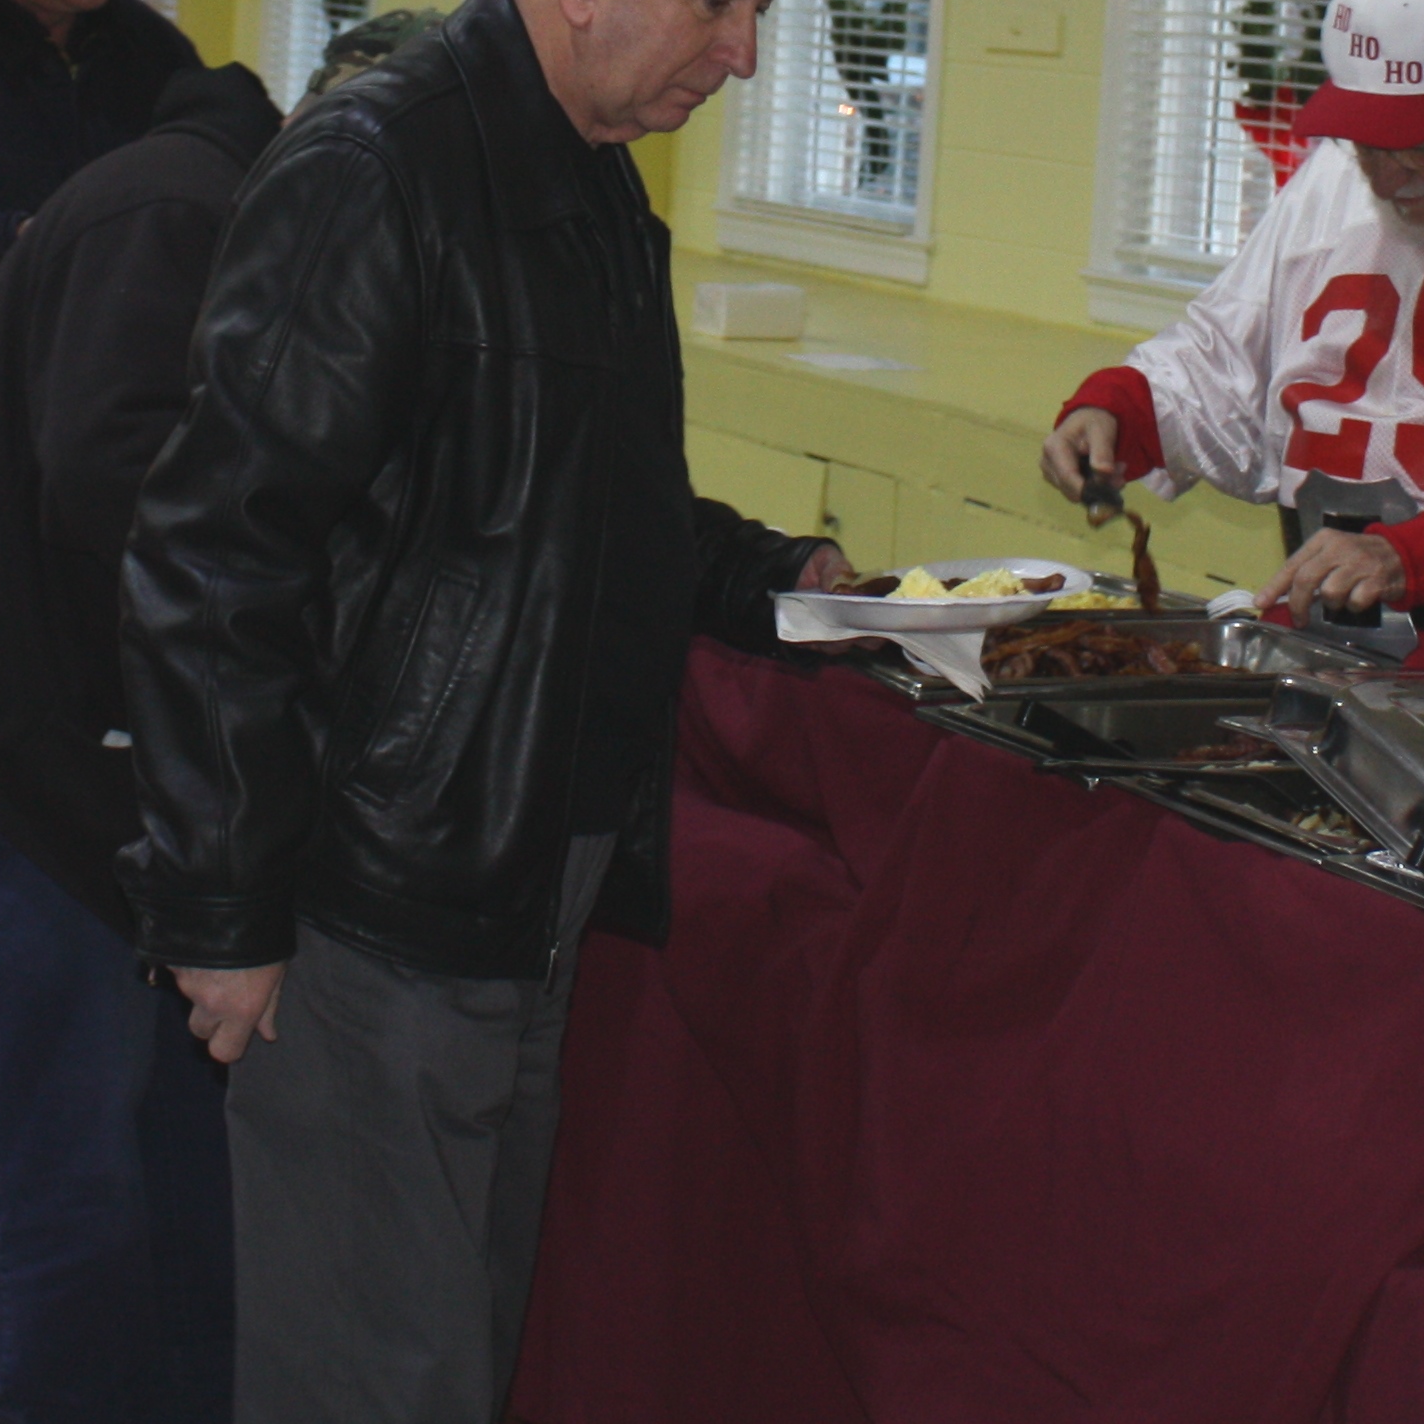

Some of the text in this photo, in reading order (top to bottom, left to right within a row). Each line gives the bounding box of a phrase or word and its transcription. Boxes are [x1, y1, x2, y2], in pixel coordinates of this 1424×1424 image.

[1333, 3, 1353, 33] HO
[1349, 32, 1381, 61] HO
[1383, 60, 1424, 85] HO
